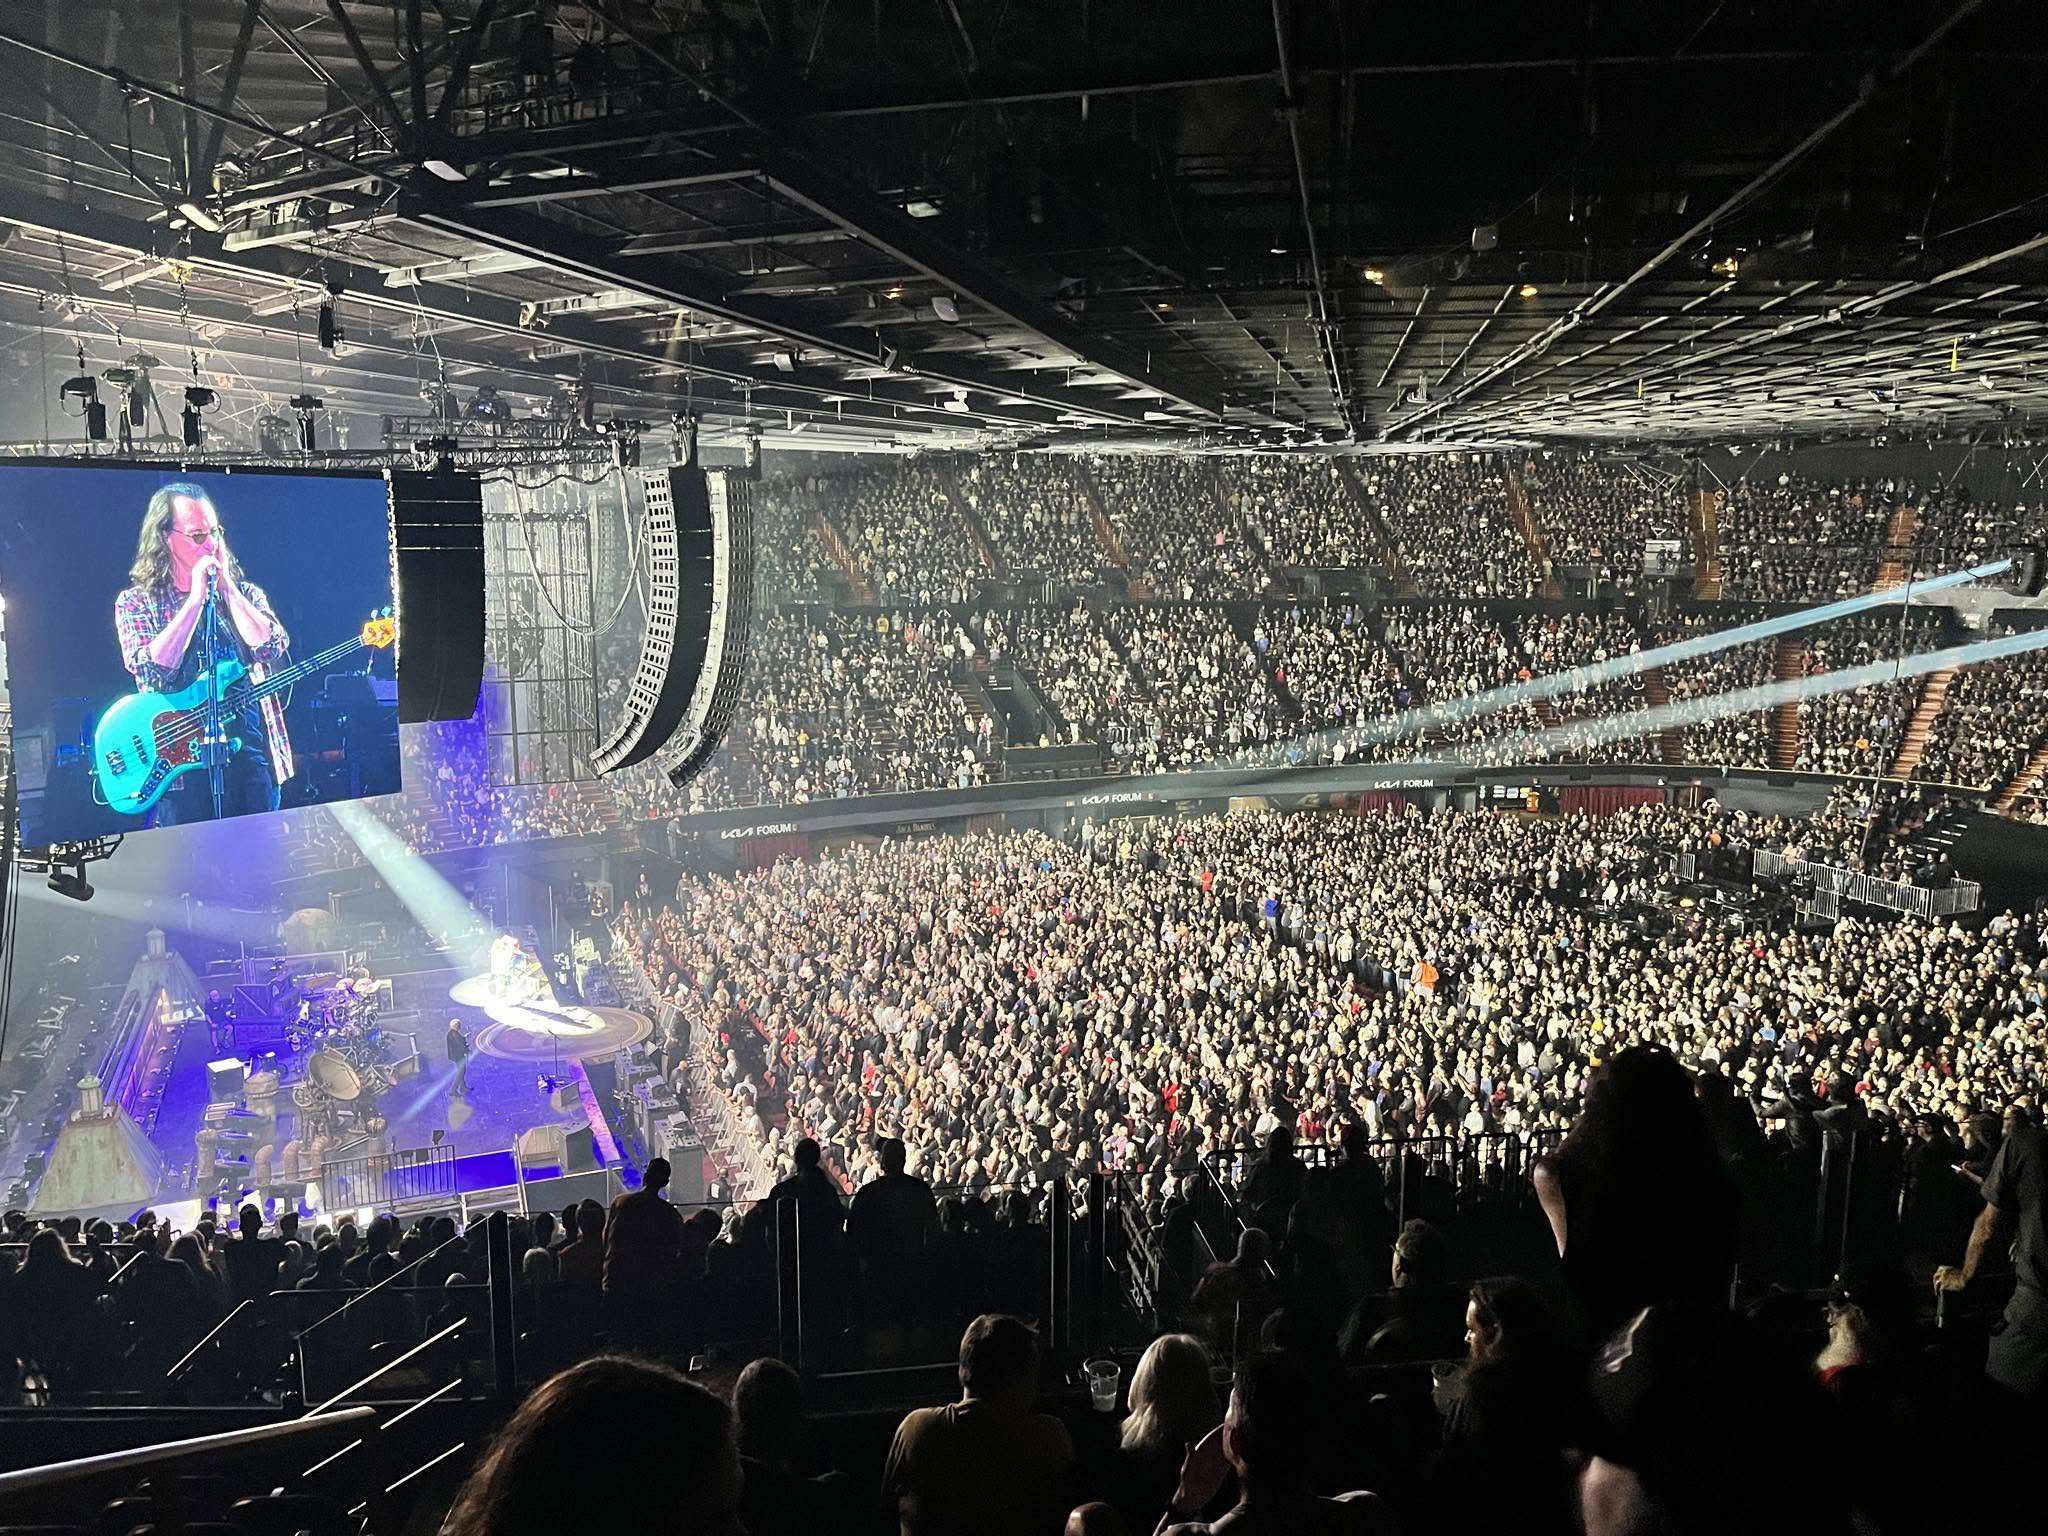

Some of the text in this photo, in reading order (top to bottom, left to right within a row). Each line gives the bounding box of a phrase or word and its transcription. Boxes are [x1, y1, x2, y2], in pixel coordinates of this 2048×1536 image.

[1403, 779, 1433, 788] FORUM
[1112, 793, 1141, 803] FORUM
[757, 824, 791, 835] FORUM
